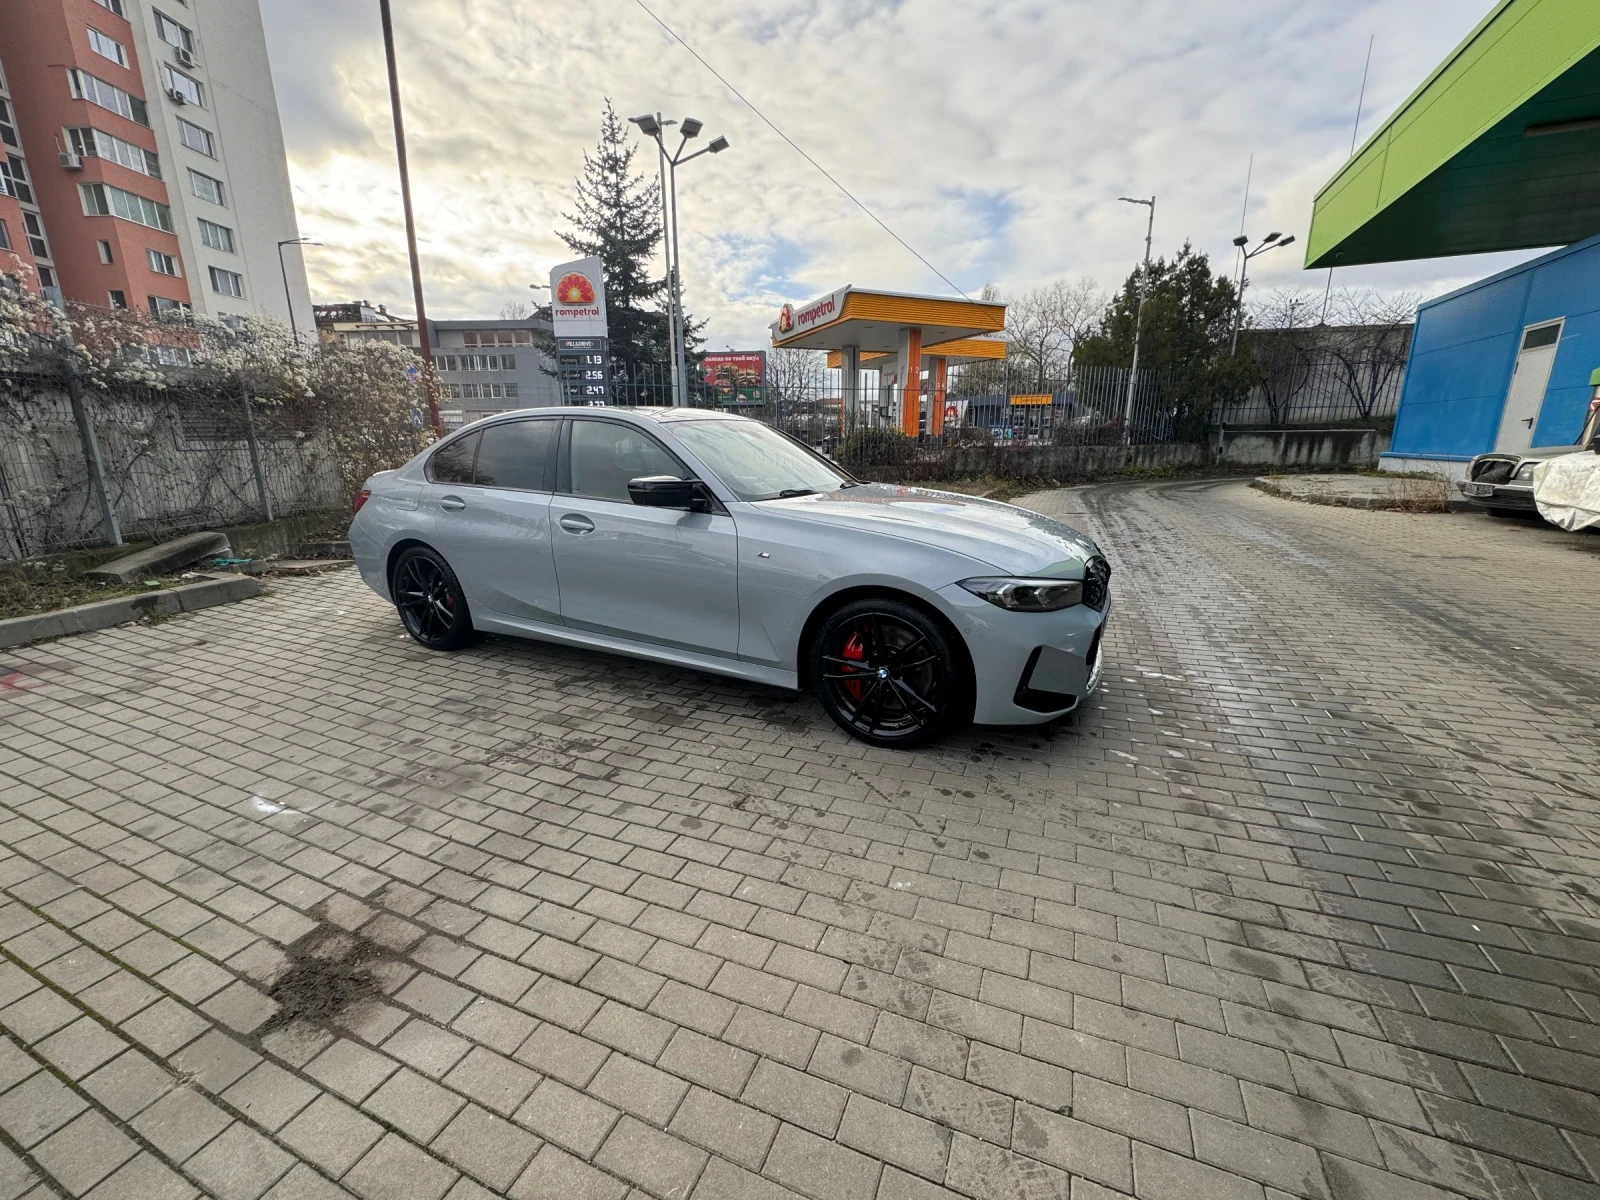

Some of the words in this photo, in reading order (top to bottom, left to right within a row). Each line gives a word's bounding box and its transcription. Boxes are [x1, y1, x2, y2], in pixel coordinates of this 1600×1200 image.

[556, 307, 599, 318] rompetrol
[798, 294, 835, 326] rompetrol
[586, 355, 602, 365] 1.13
[586, 370, 603, 380] 2.56
[586, 385, 604, 395] 2.47
